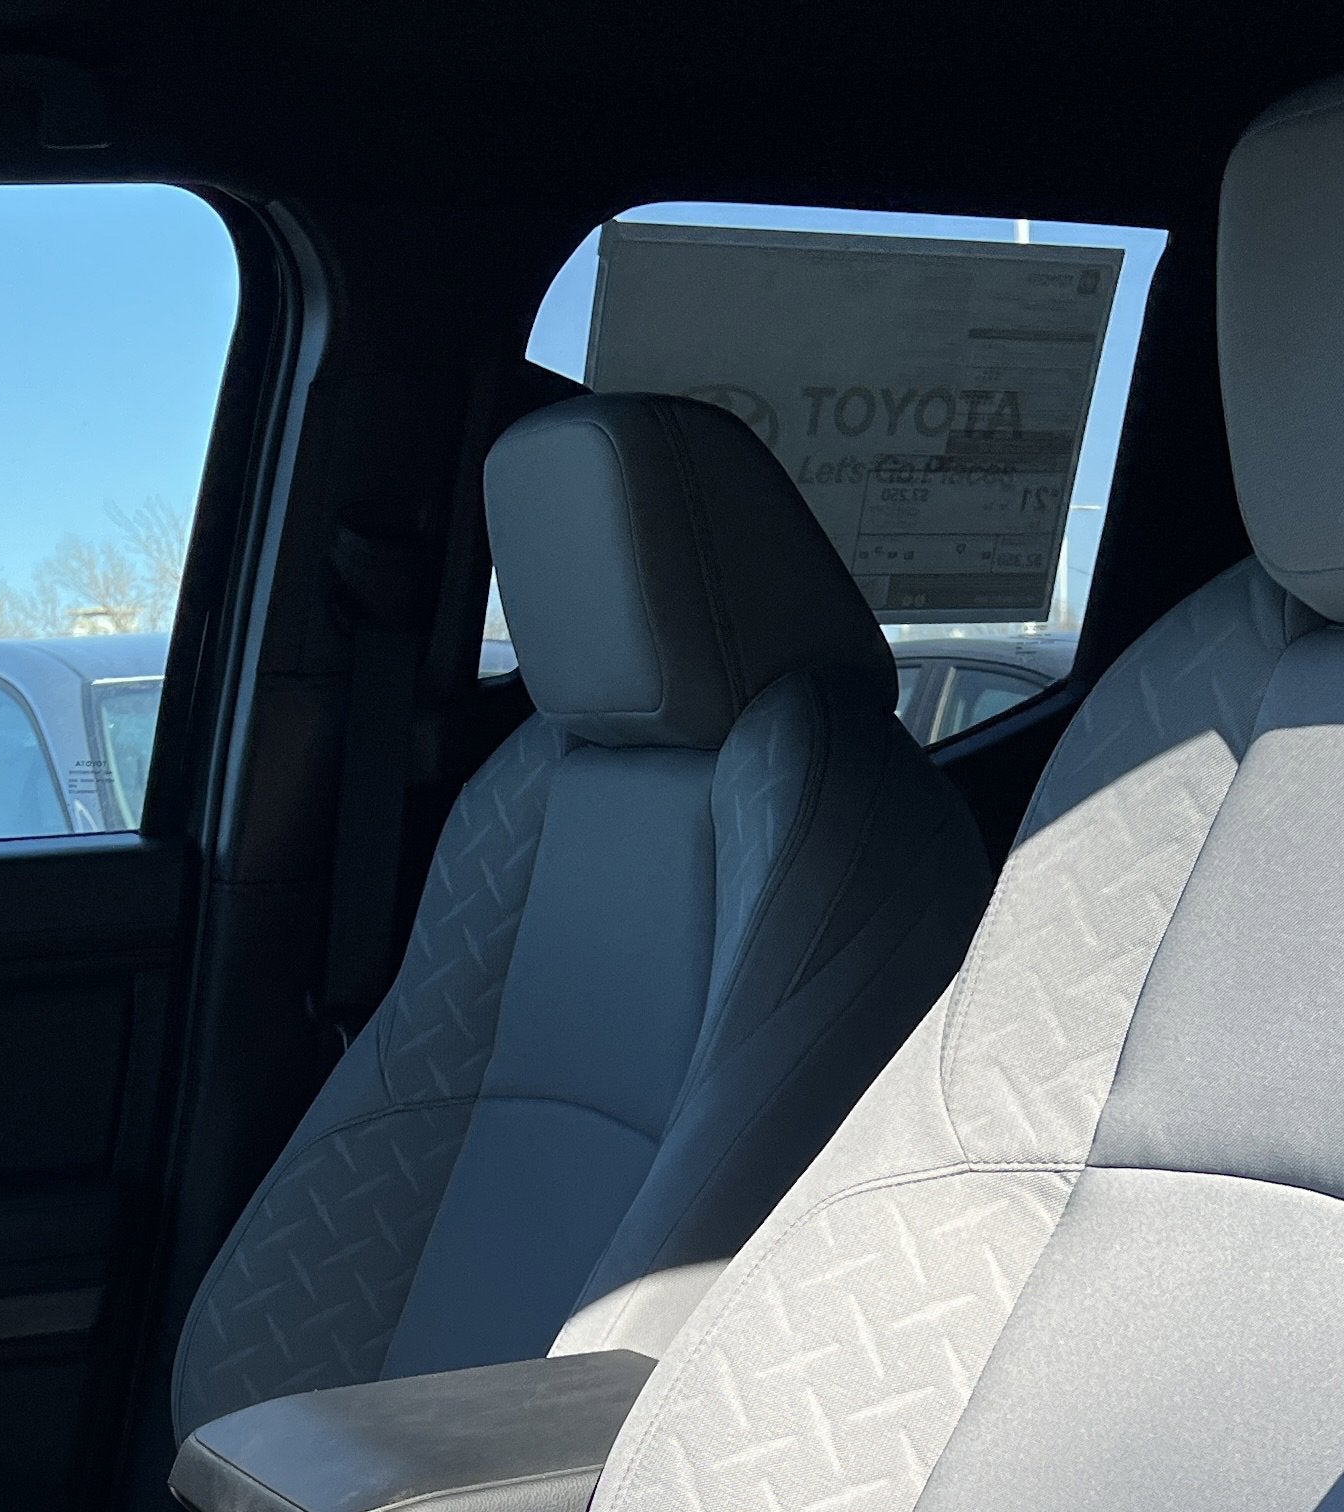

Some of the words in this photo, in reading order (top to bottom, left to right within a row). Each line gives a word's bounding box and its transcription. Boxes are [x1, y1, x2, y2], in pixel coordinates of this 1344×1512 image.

[801, 385, 1024, 439] TOYOTA
[797, 455, 866, 485] Let's
[875, 453, 915, 485] Go
